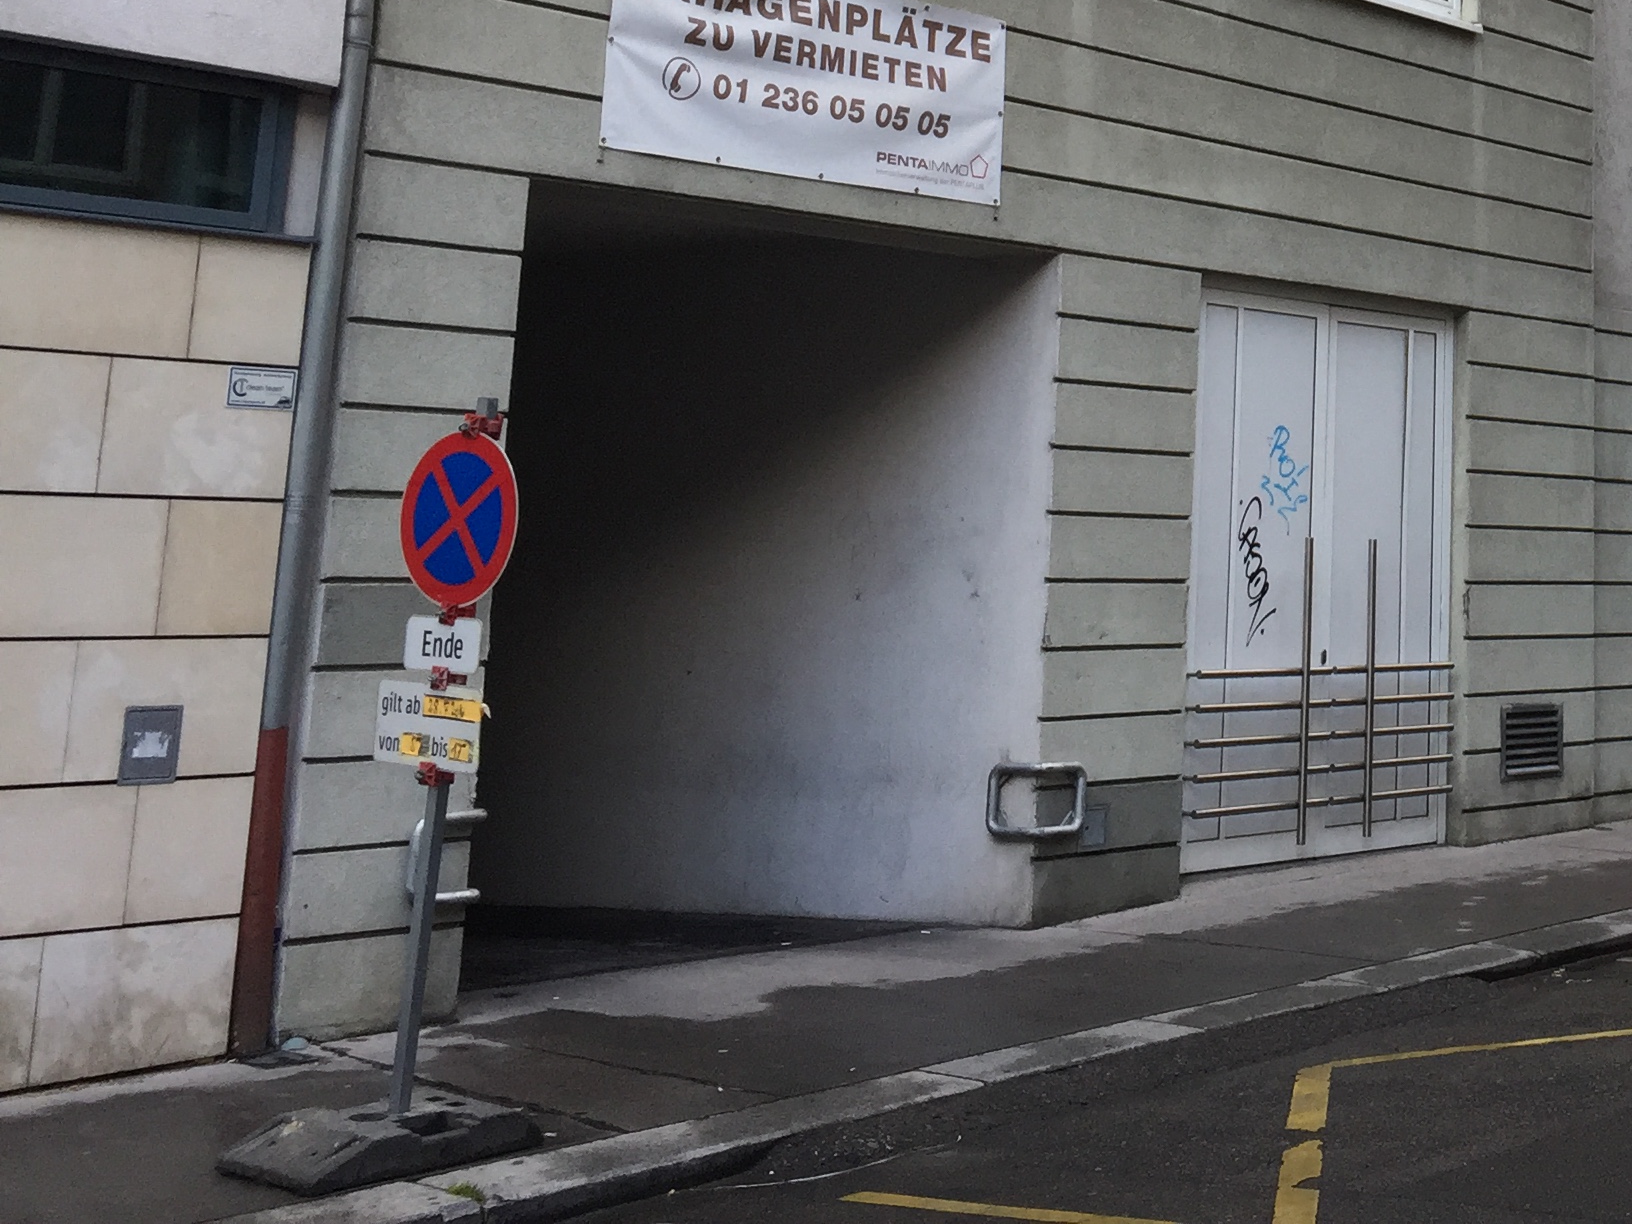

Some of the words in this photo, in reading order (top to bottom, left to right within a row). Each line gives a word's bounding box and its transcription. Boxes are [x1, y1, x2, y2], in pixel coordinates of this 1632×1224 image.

[683, 16, 735, 51] ZU
[752, 29, 948, 93] VERMIETEN
[712, 74, 748, 104] 01
[761, 82, 820, 116] 236
[830, 94, 866, 124] 05
[875, 102, 911, 133] 05
[917, 109, 952, 140] 05
[422, 630, 464, 660] Ende
[381, 691, 403, 716] gilt
[405, 695, 421, 715] ab
[378, 735, 400, 753] von
[431, 737, 448, 758] bis
